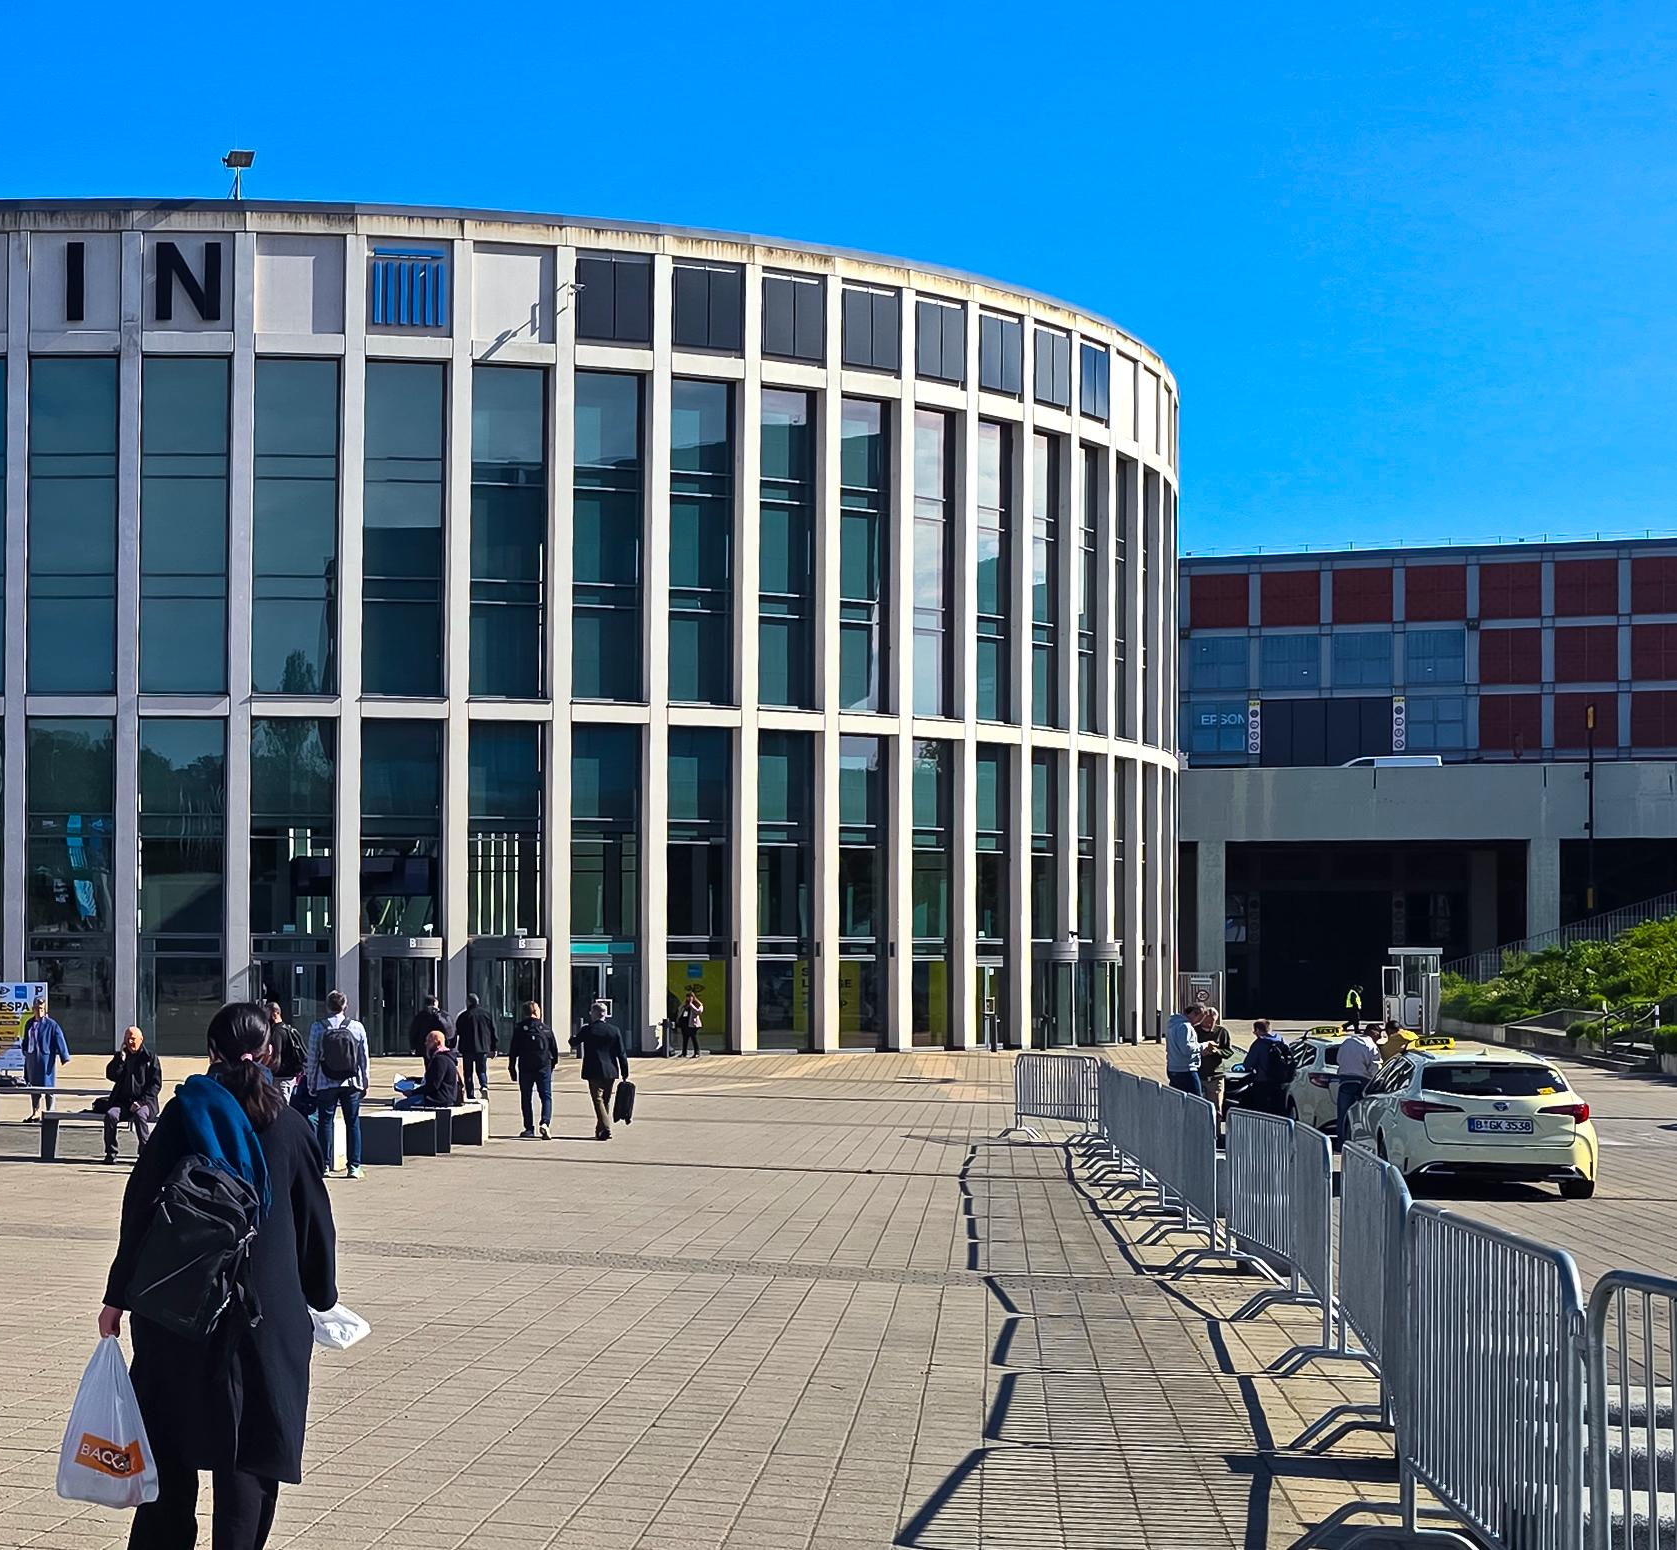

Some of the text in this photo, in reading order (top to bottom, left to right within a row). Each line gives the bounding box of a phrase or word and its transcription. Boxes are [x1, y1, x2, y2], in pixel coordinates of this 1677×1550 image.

[35, 985, 43, 996] P
[1475, 1120, 1531, 1131] B GK 3538
